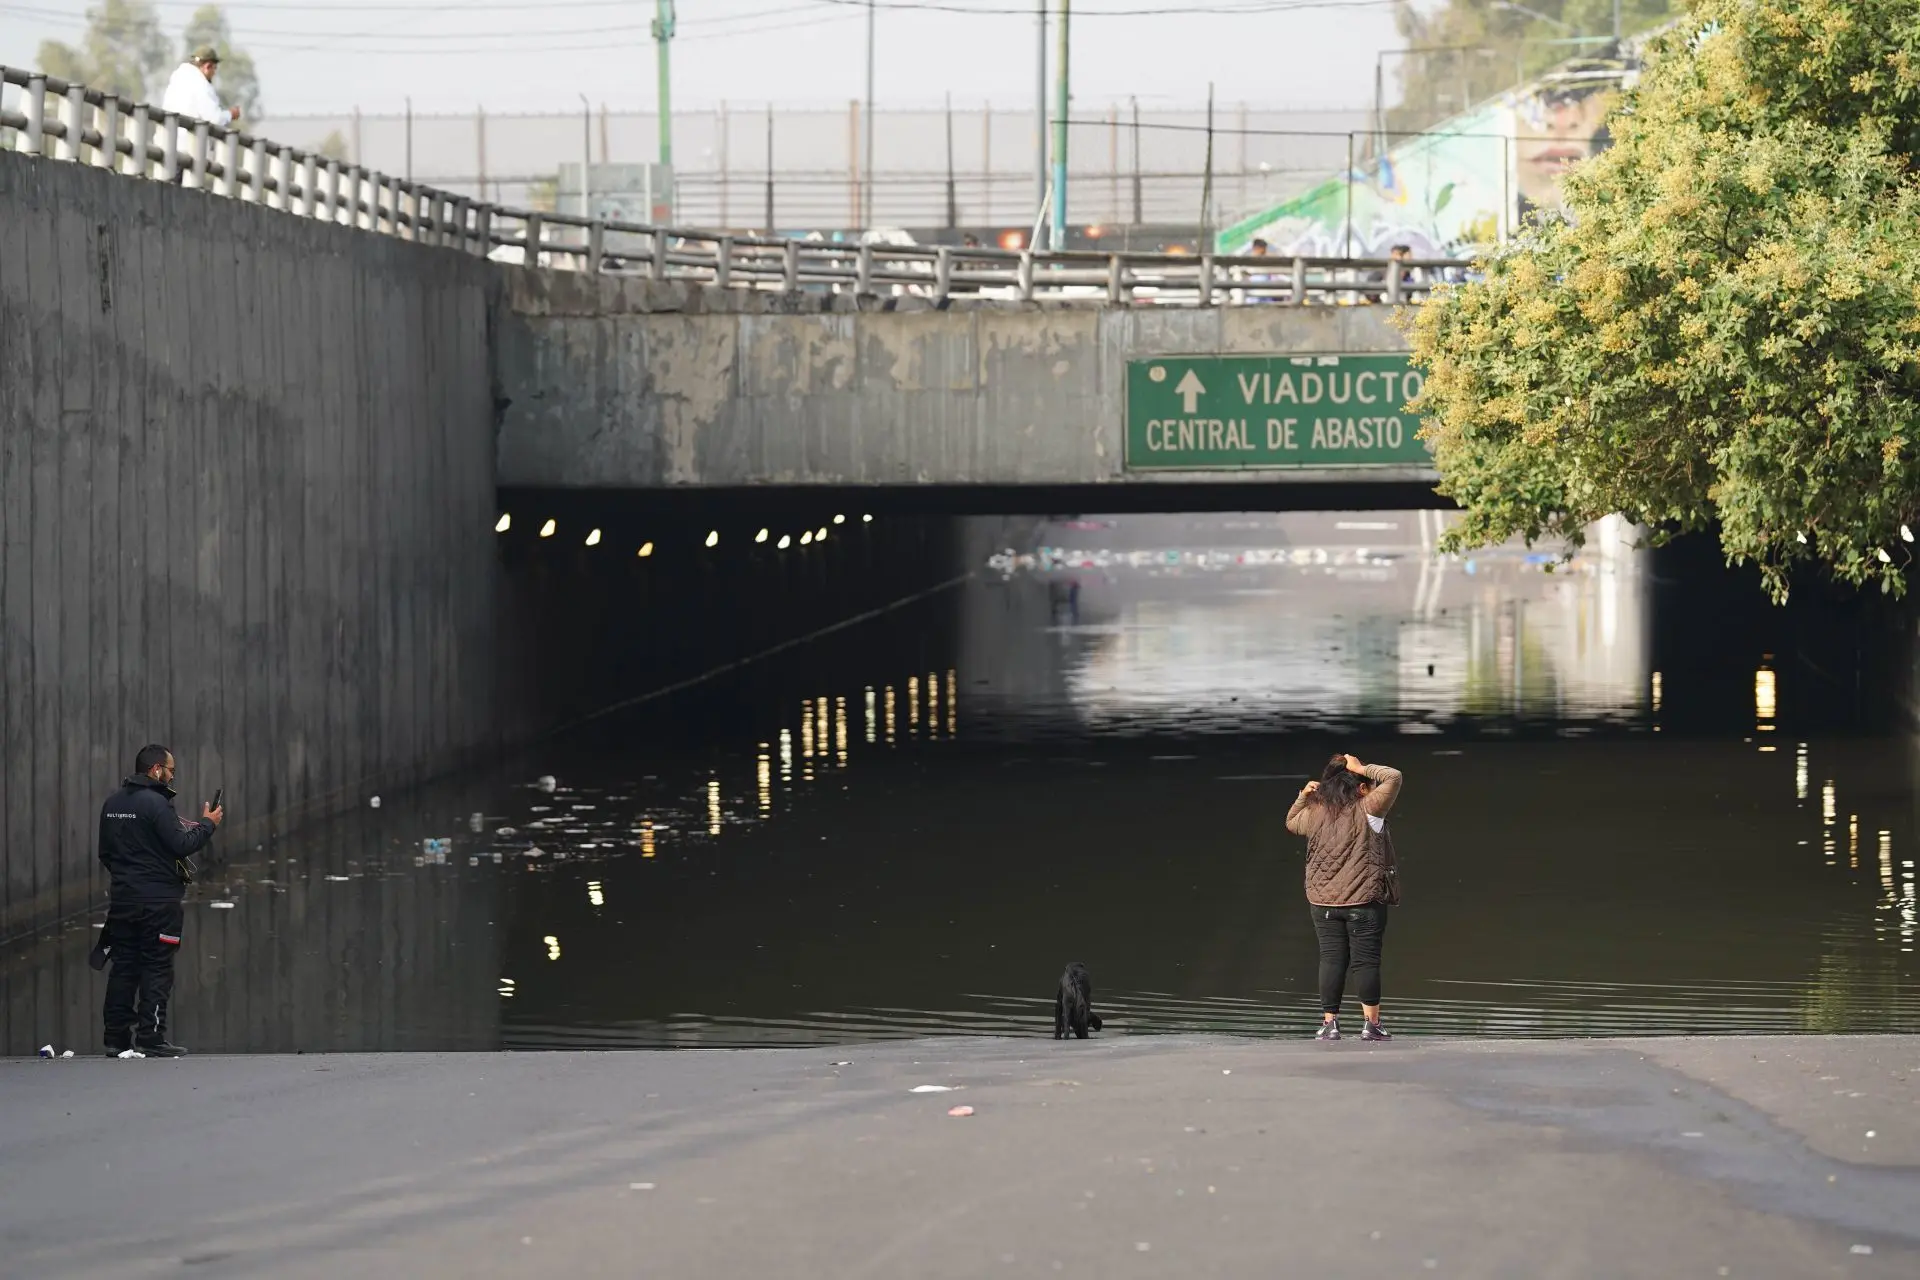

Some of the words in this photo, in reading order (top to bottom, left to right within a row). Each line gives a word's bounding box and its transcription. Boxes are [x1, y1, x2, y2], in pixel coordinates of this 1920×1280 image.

[1237, 371, 1424, 404] VIADUCTO
[1147, 419, 1255, 450] CENTRAL
[1266, 418, 1298, 449] DE
[1311, 417, 1402, 449] ABASTO
